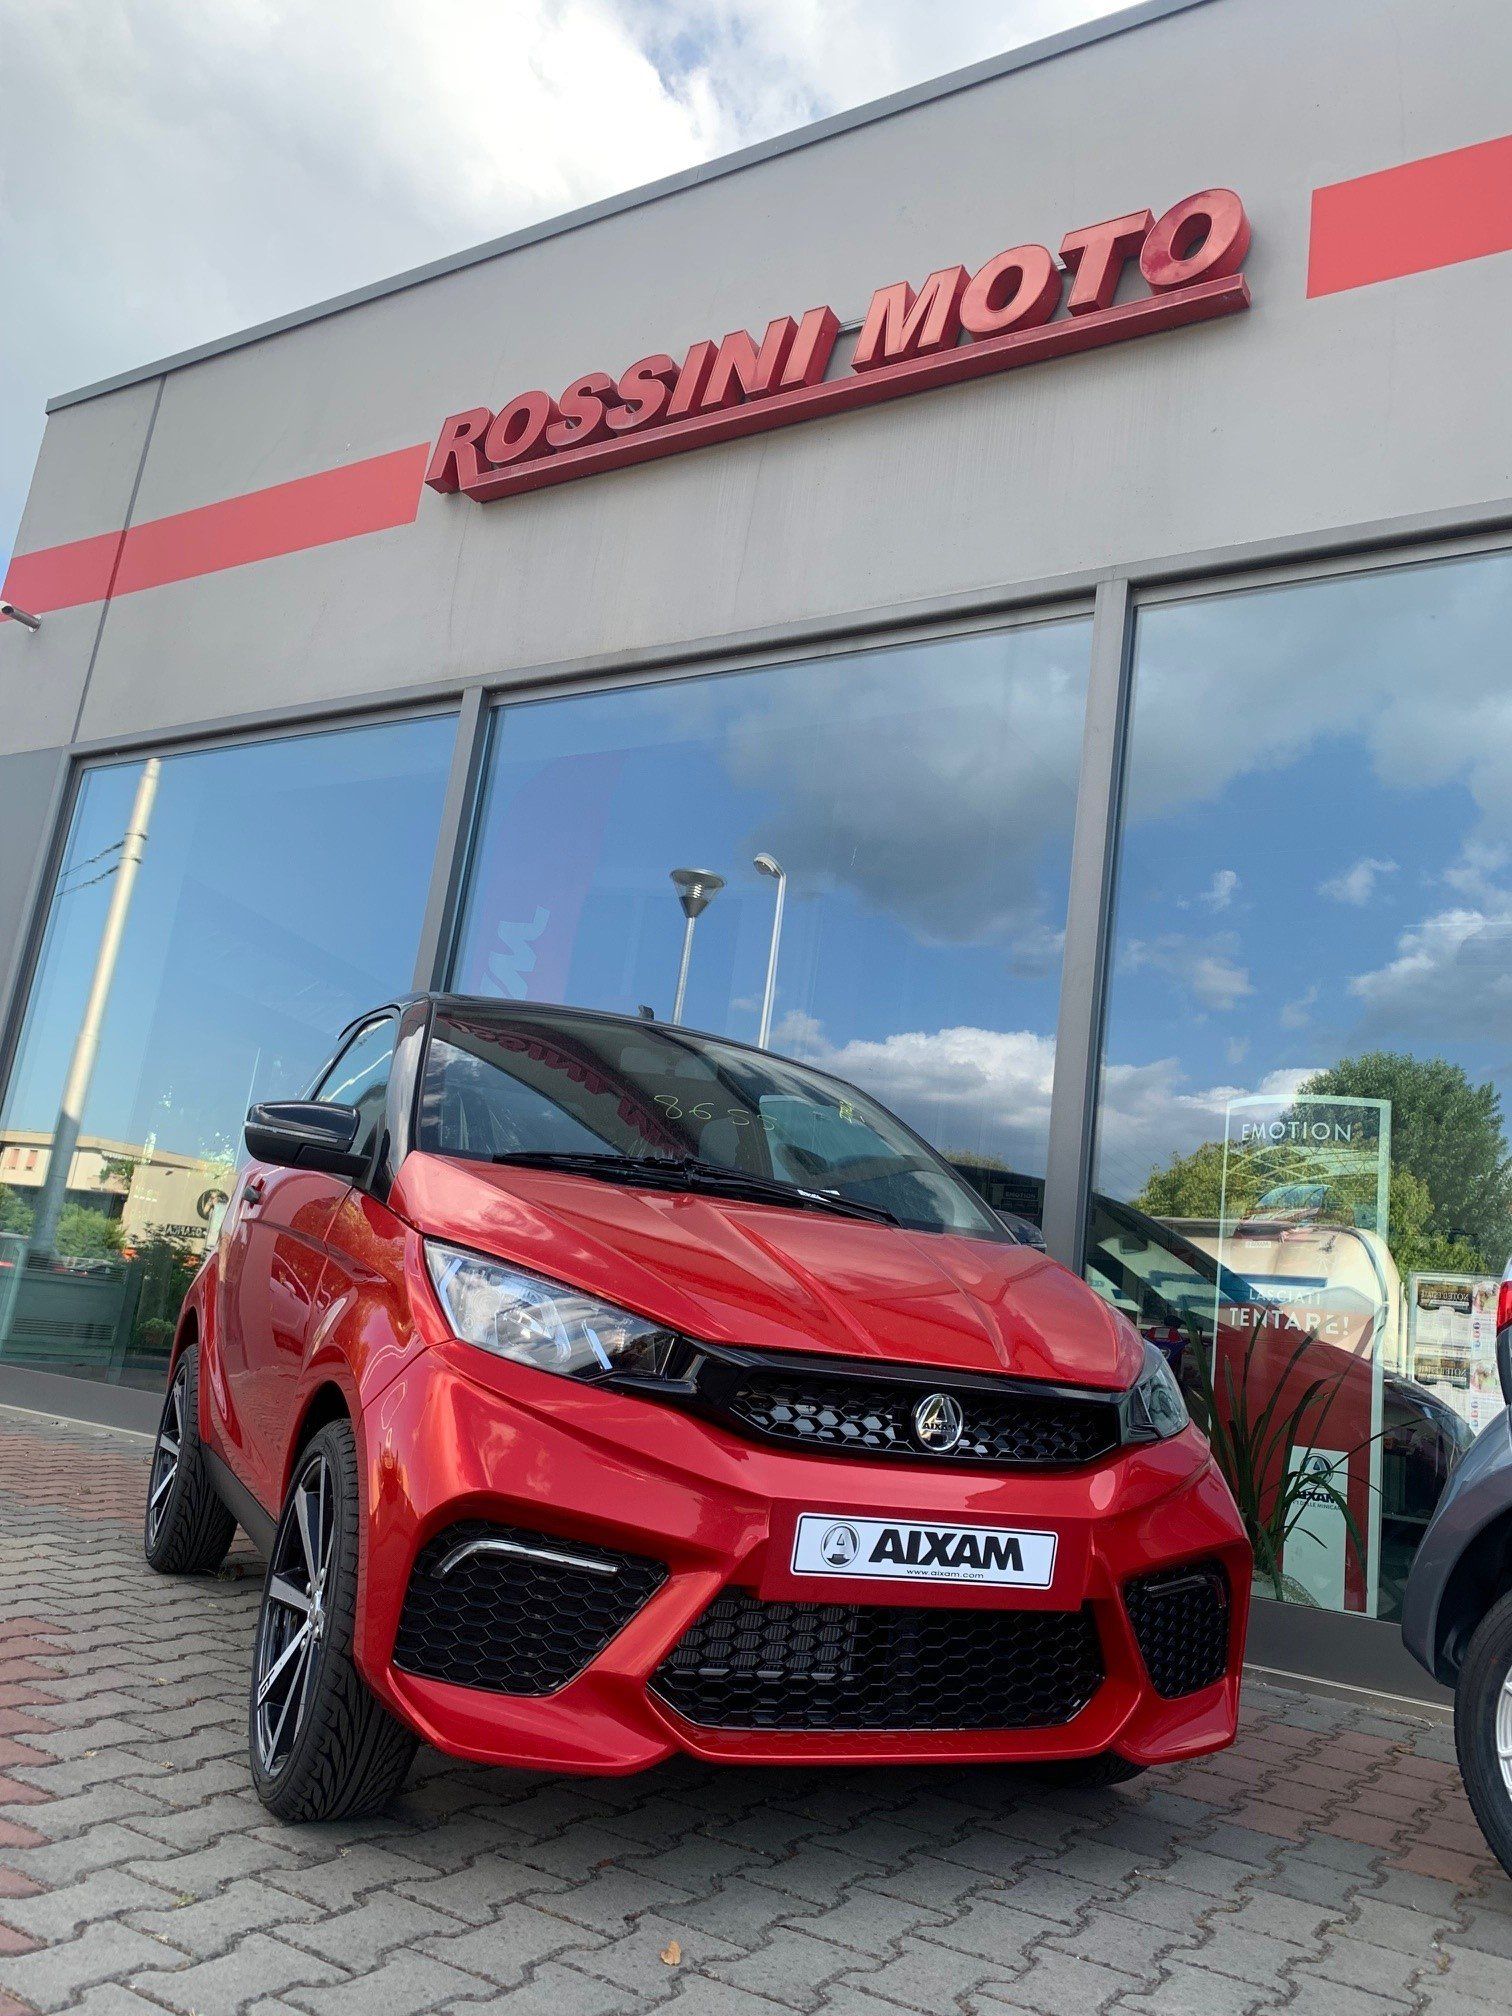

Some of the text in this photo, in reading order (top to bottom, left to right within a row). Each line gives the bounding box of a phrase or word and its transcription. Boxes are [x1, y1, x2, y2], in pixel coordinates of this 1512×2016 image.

[425, 188, 1251, 491] ROSSINI MOTO
[1241, 1121, 1351, 1142] EMOTION
[1249, 1288, 1321, 1305] LASCIATI
[1229, 1306, 1349, 1336] TENTARE!
[868, 1528, 1024, 1572] AIXAM
[906, 1568, 985, 1580] www.aixam.com
